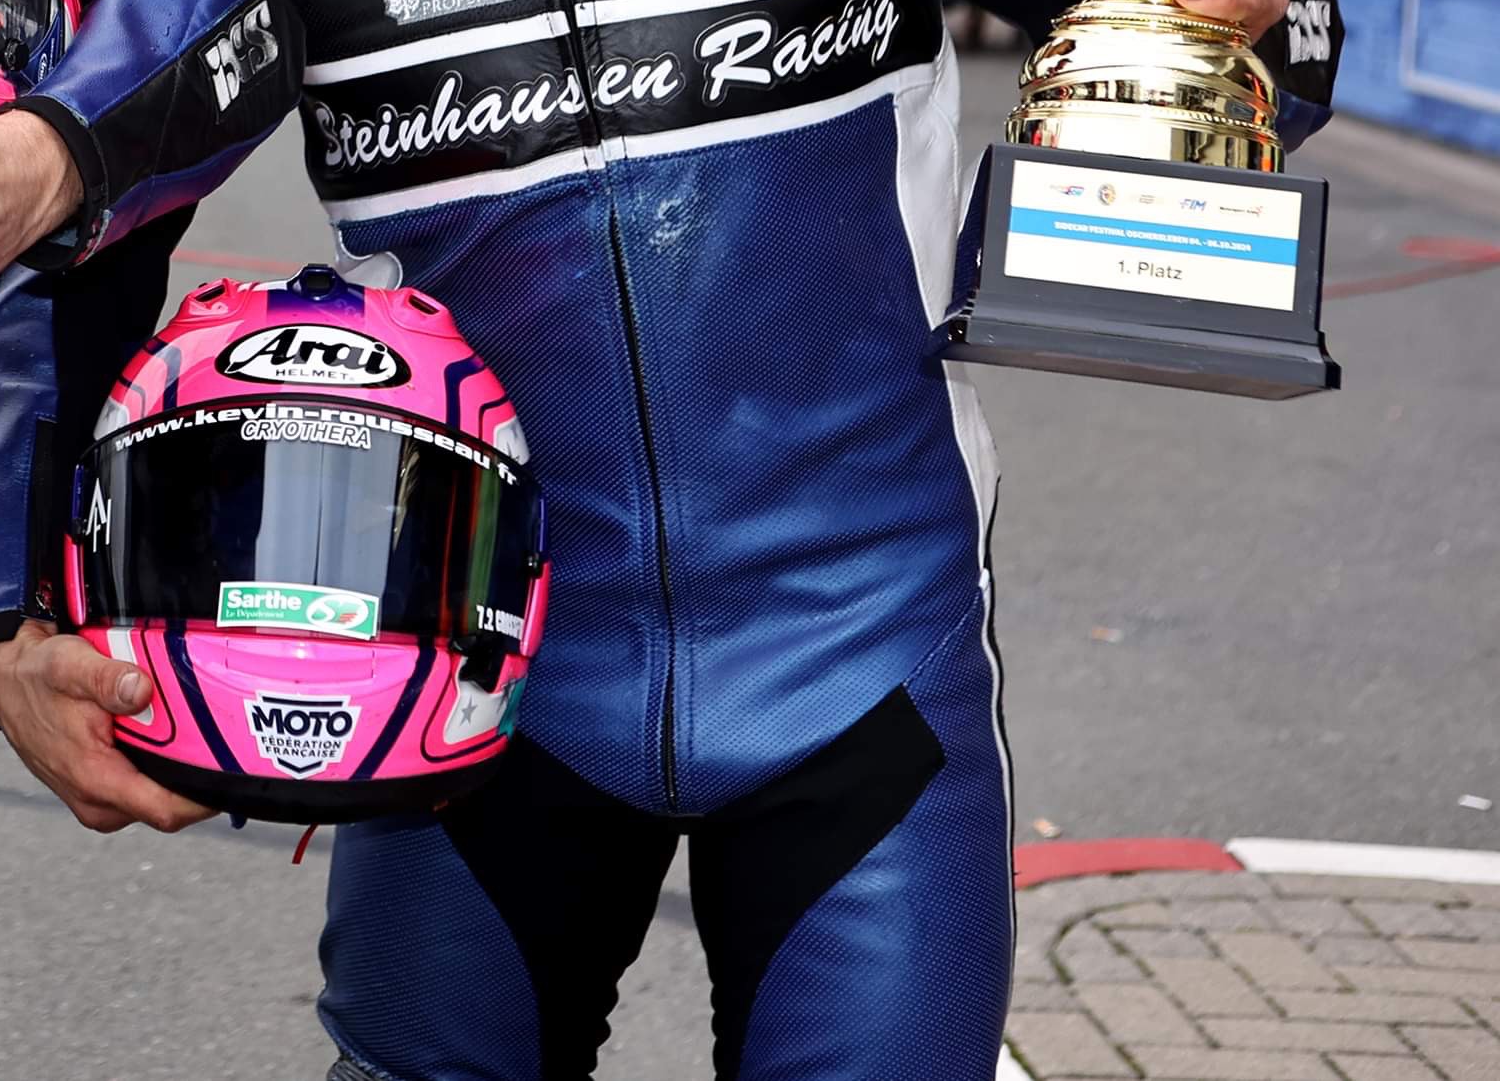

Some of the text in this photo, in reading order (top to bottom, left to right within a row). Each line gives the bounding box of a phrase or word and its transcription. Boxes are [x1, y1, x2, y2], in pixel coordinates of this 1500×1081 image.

[317, 57, 679, 168] Steinhausen
[1118, 260, 1183, 281] 1. Platz
[225, 327, 390, 375] Arai
[275, 368, 349, 381] HELMET
[241, 419, 372, 449] CRYOTHERA
[227, 589, 302, 611] Sarthe
[251, 704, 353, 738] MOTO
[261, 734, 342, 750] FÉDÉRATION
[265, 745, 337, 759] FRANÇAISE
